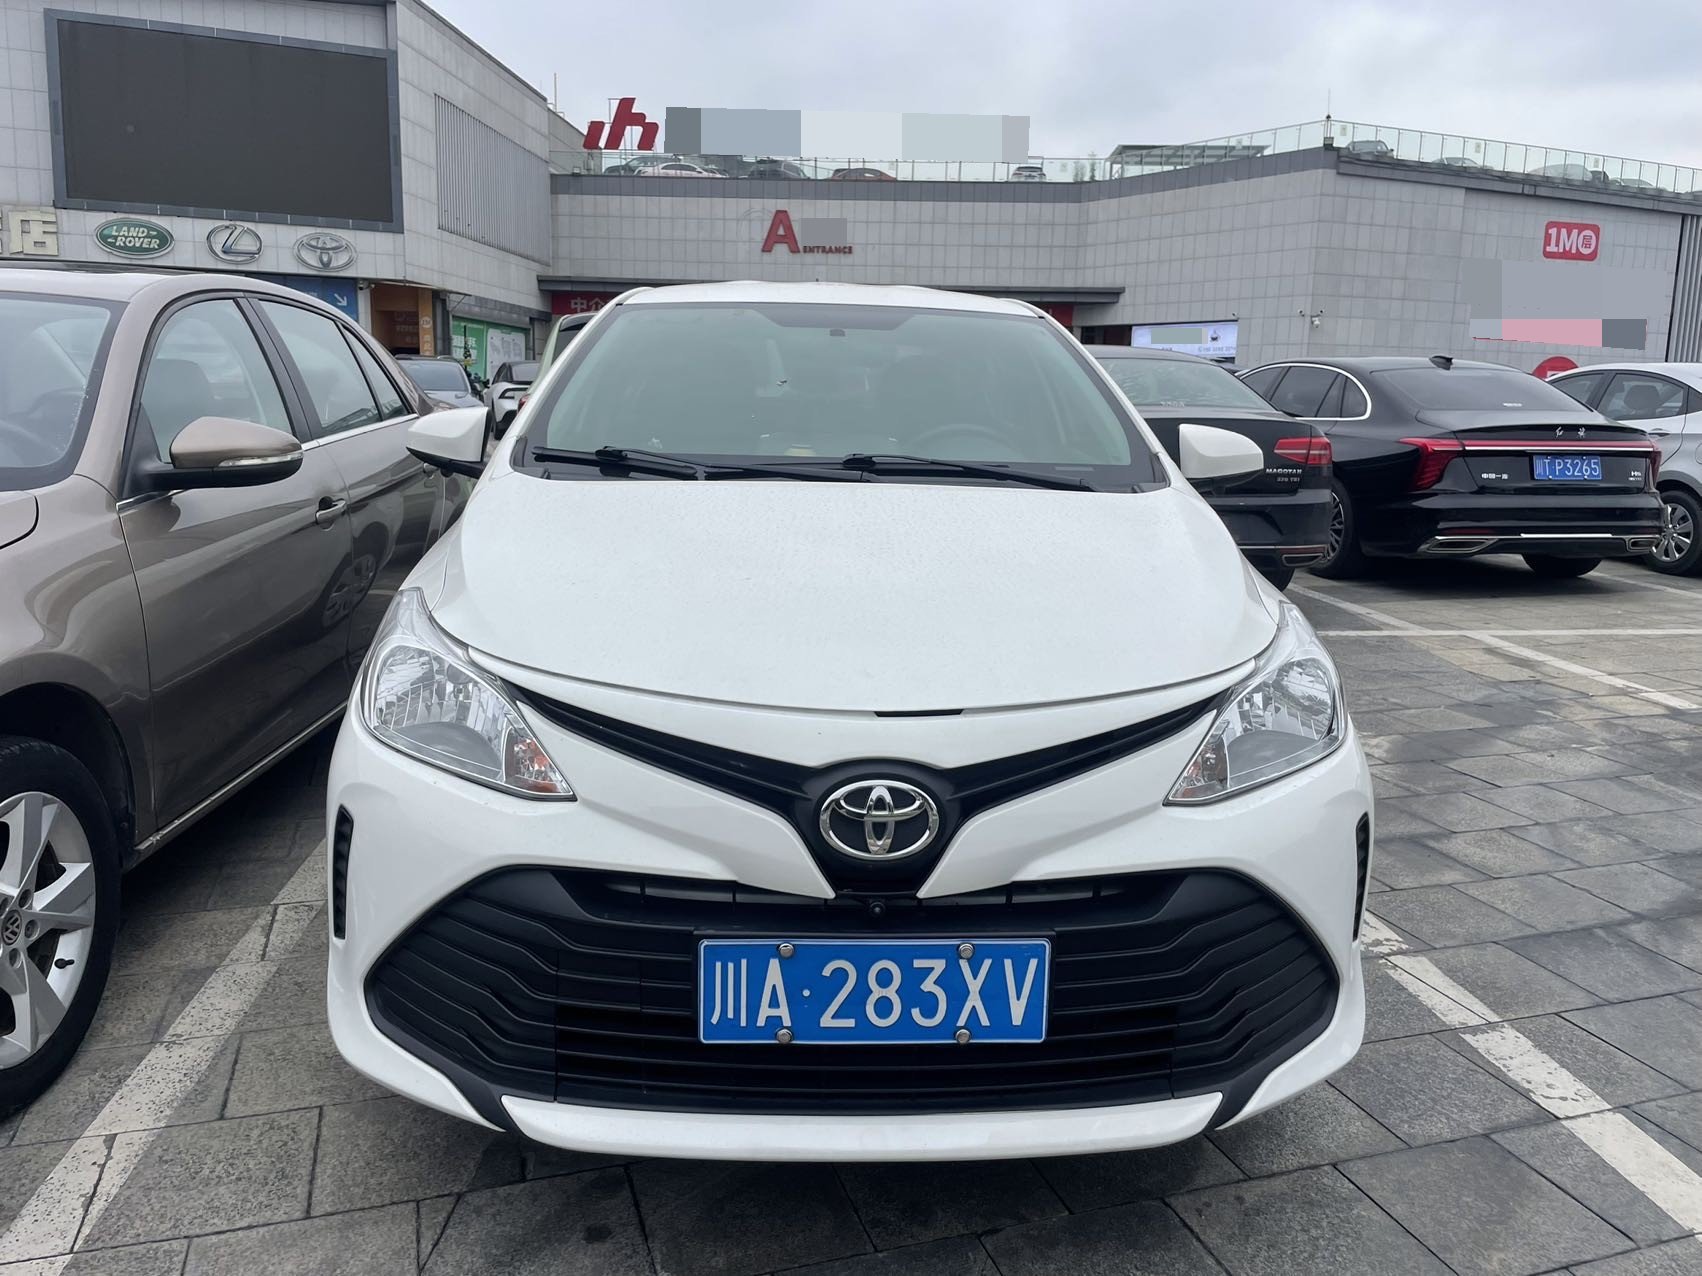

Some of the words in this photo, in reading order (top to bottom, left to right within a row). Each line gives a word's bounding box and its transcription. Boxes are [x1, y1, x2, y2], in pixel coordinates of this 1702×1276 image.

[0, 211, 58, 256] 店
[761, 210, 800, 253] A
[803, 246, 853, 254] ENTRANCE
[710, 958, 1038, 1028] 川A·283XV
